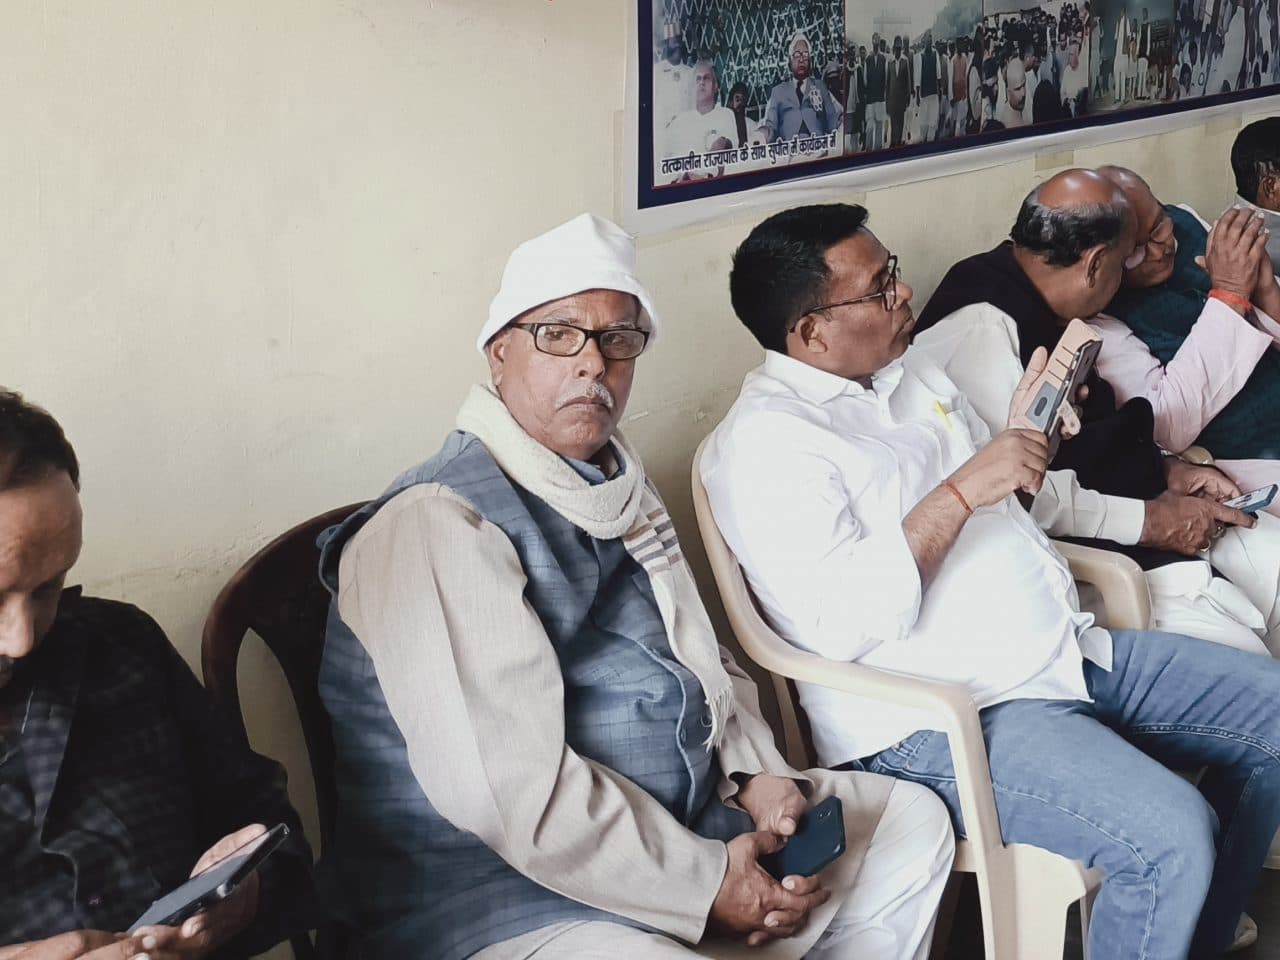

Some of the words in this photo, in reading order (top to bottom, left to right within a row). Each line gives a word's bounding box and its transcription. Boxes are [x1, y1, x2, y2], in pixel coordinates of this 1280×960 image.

[661, 151, 702, 174] तत्कालीन
[703, 149, 738, 168] राज्यपाल
[740, 143, 749, 162] के
[751, 144, 766, 161] साथ
[790, 134, 798, 155] में
[799, 133, 830, 154] कार्यक्रम
